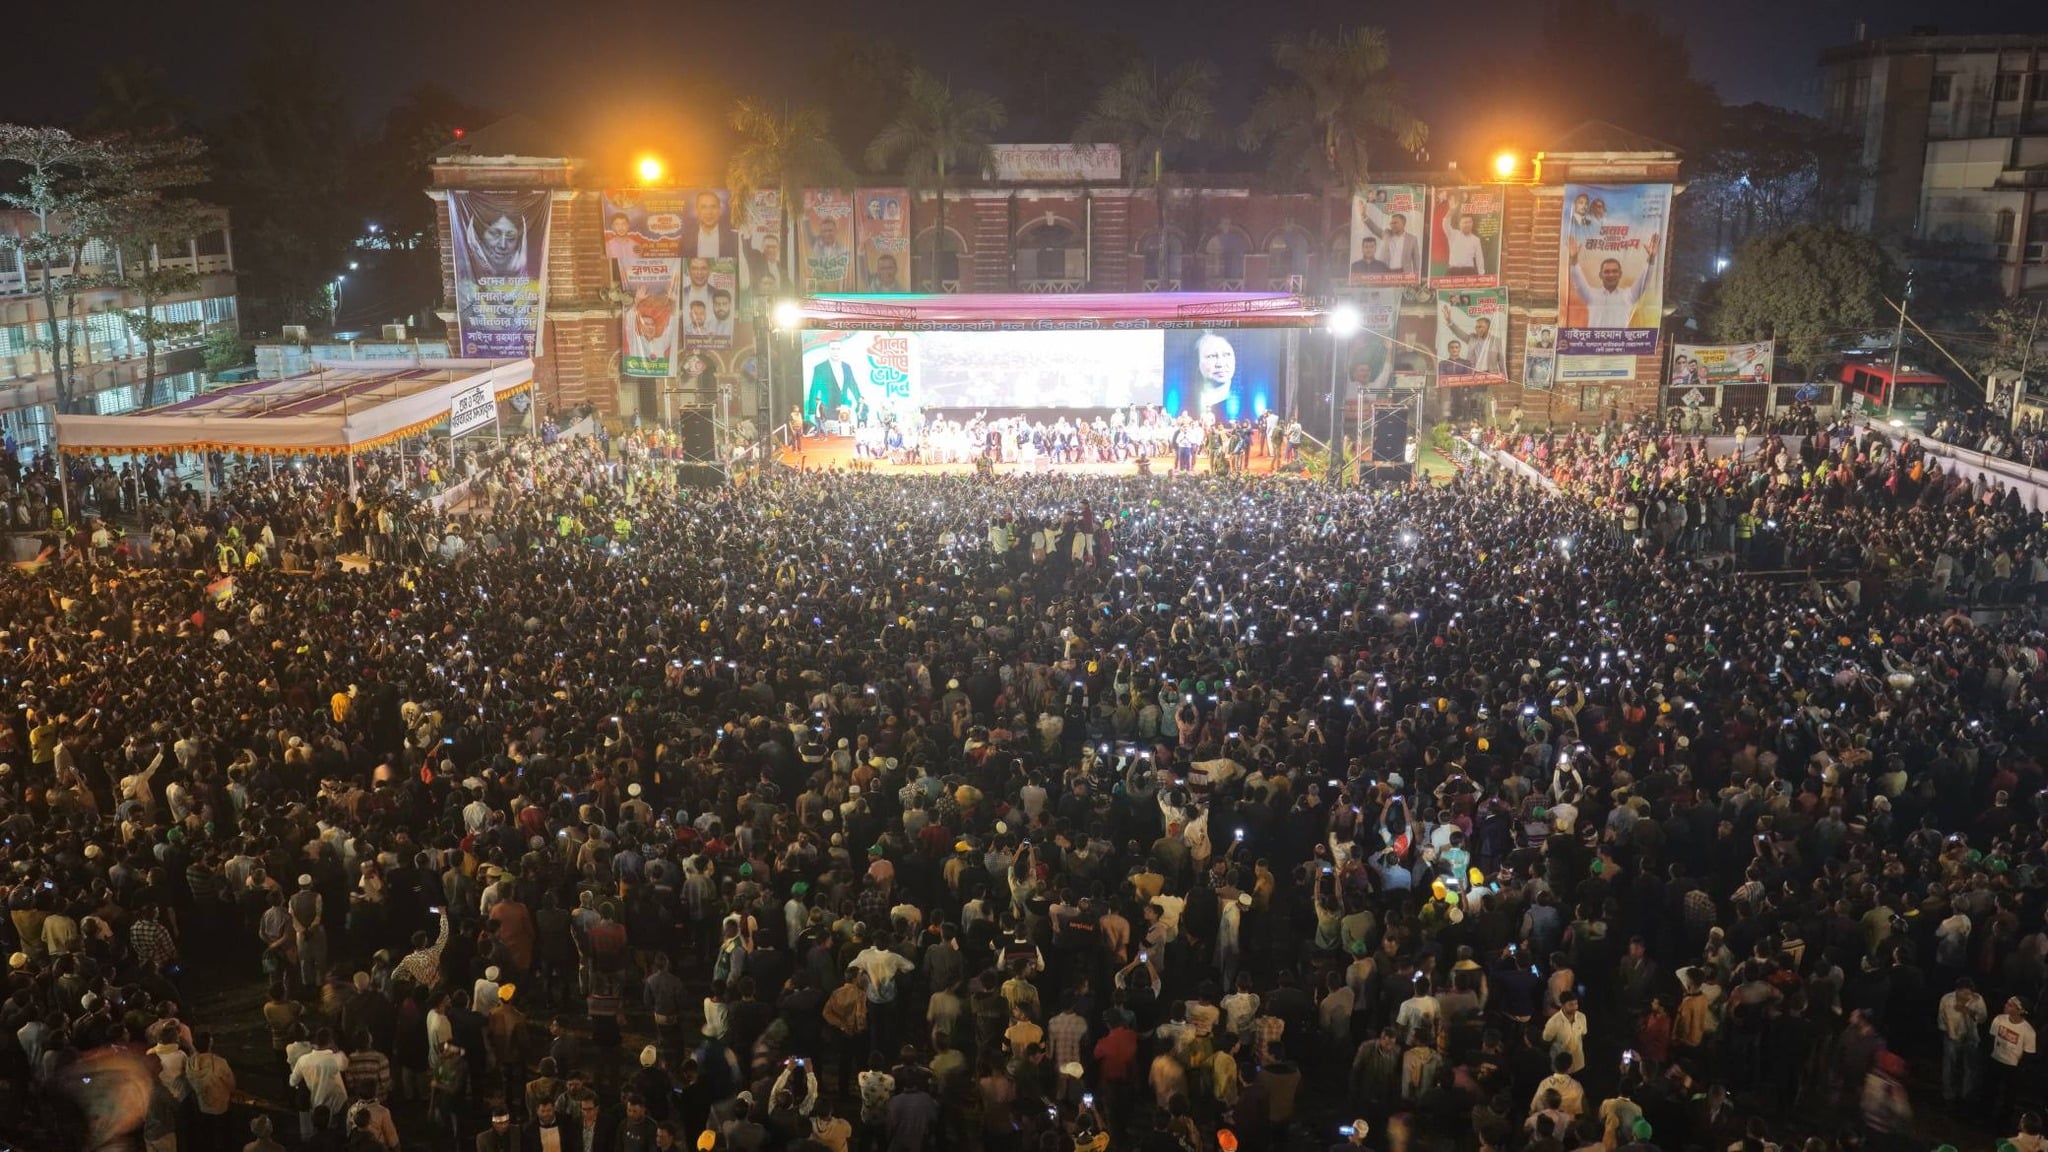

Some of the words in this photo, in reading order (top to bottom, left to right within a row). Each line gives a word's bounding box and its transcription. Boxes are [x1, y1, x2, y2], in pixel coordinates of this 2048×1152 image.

[827, 320, 896, 331] বাংলাদেশ
[903, 319, 996, 331] জাতীয়তাবাদী
[1001, 321, 1024, 330] দল
[1112, 319, 1150, 330] ফেনী
[1155, 320, 1194, 330] জেলা
[1594, 330, 1622, 341] রহমান
[1624, 330, 1650, 342] জুয়েল
[869, 335, 908, 354] ধানের
[867, 354, 908, 386] ভোট
